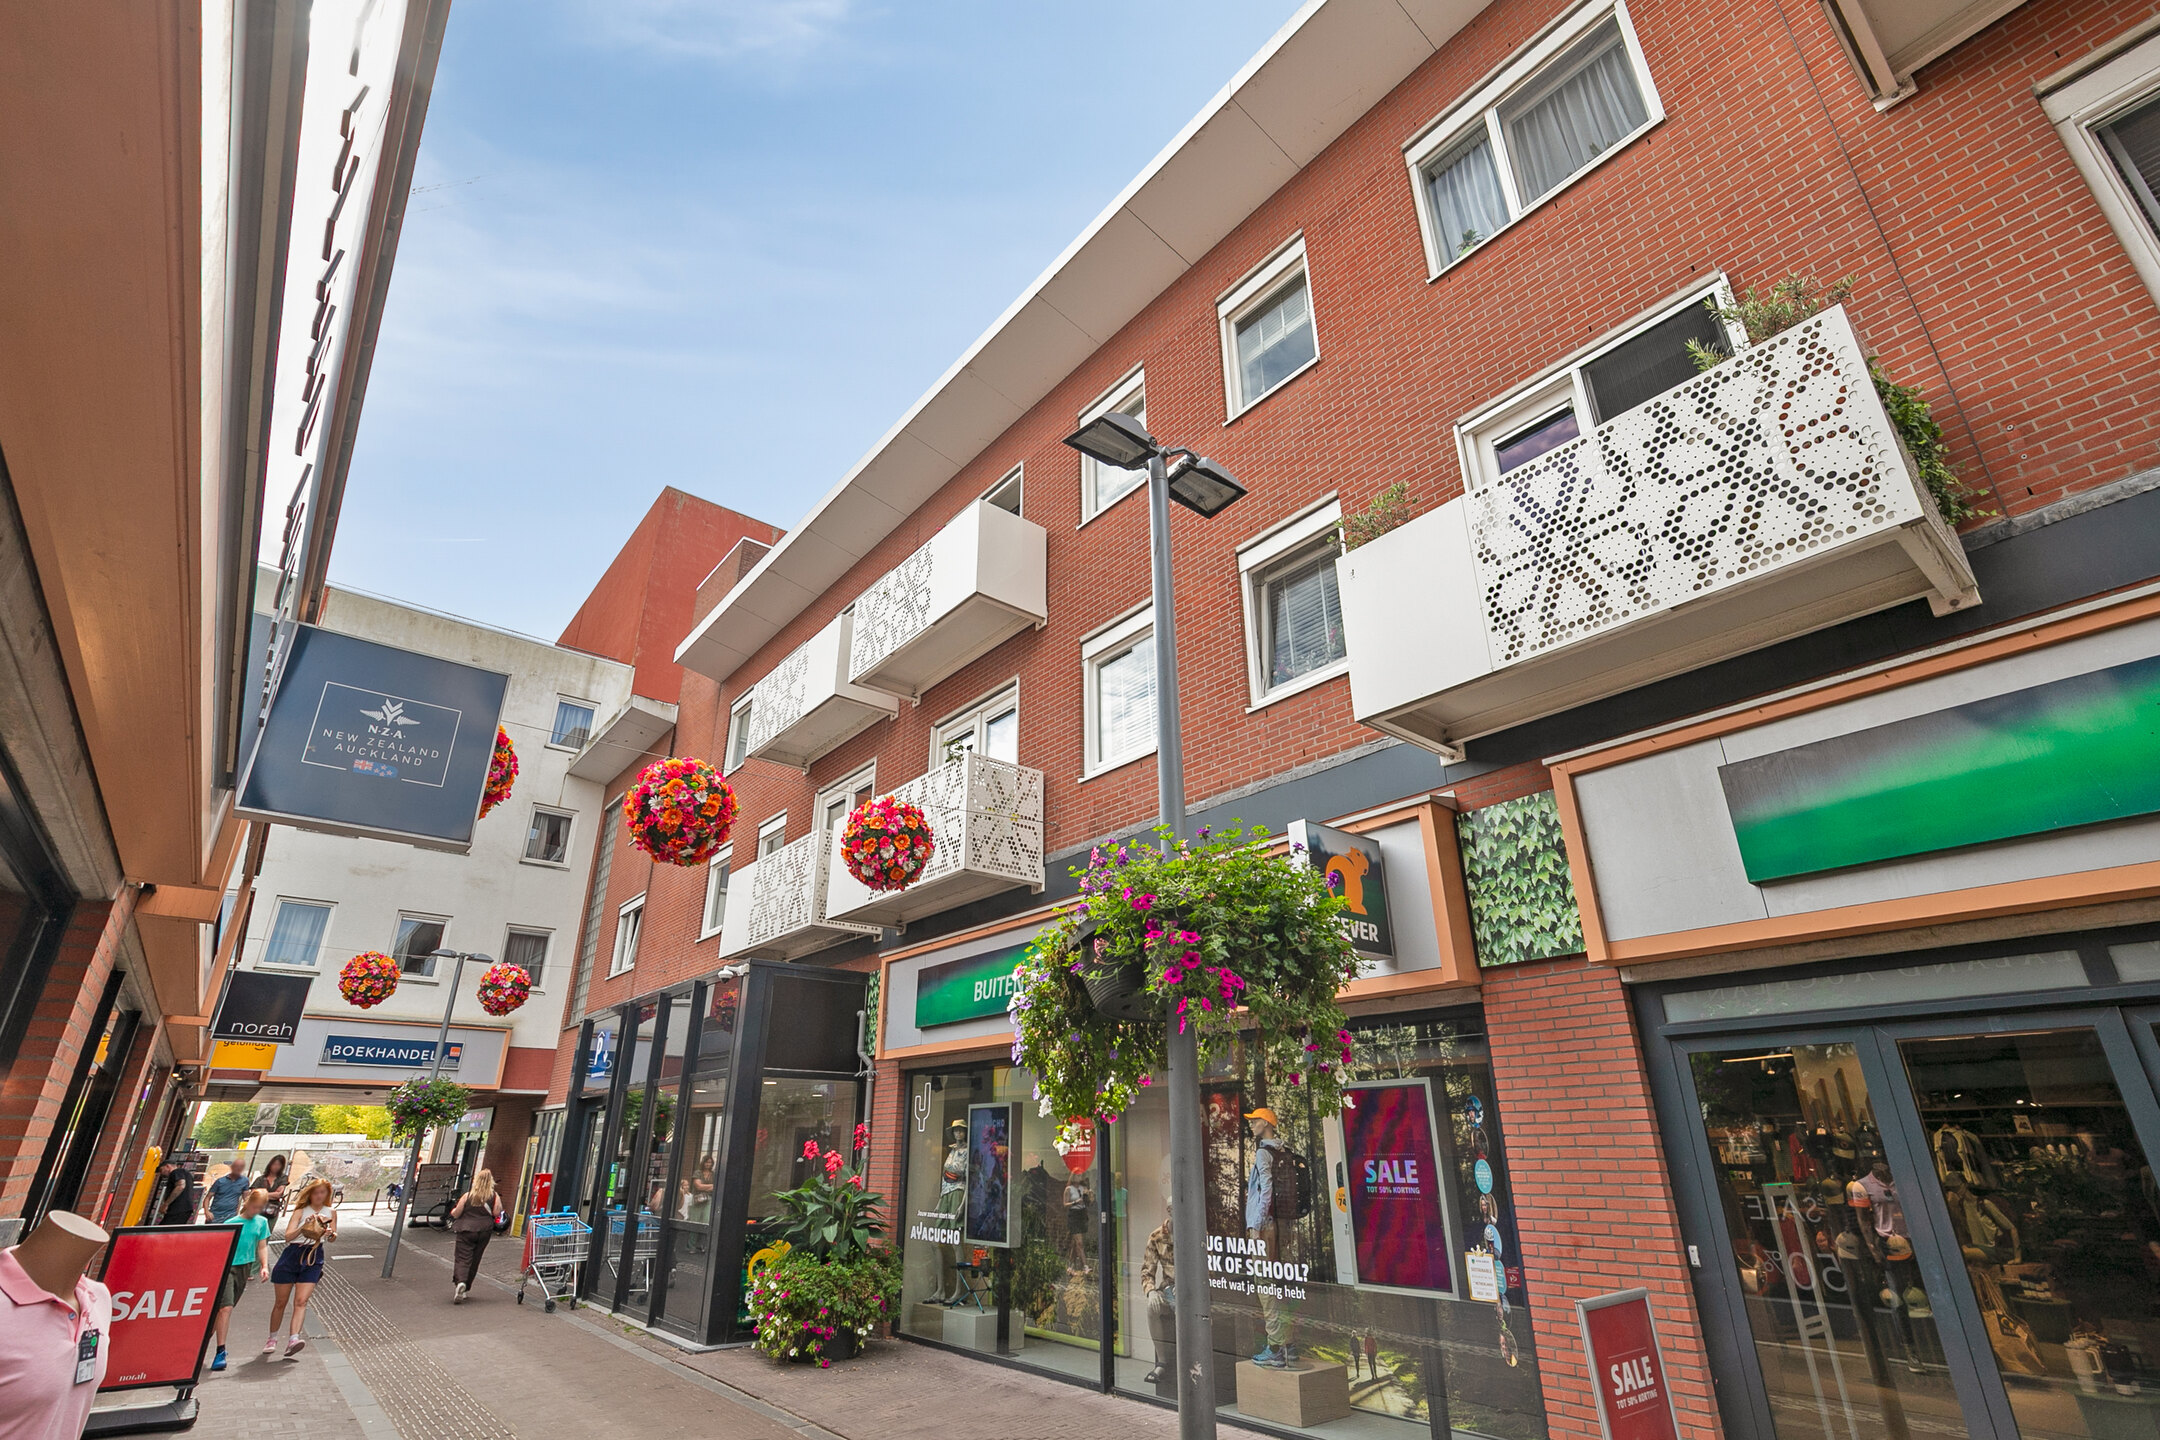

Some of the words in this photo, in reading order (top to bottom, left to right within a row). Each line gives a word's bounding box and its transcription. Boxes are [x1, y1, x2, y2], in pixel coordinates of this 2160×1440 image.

[322, 728, 359, 743] NEW
[366, 737, 440, 759] ZEALAND
[334, 743, 423, 766] AUCKLAND
[230, 1021, 293, 1037] norah
[332, 1044, 437, 1061] BOEKHANDEL
[1363, 1160, 1419, 1184] SALE
[1393, 1186, 1420, 1195] KORTING
[910, 1221, 961, 1246] AYACUCHO
[1226, 1237, 1267, 1256] NAAR
[1225, 1256, 1242, 1274] OF
[1245, 1258, 1309, 1282] SCHOOL?
[1229, 1280, 1246, 1292] wat
[1246, 1281, 1255, 1296] je
[1257, 1283, 1283, 1300] nodig
[1284, 1285, 1306, 1300] hebt
[111, 1287, 209, 1322] SALE
[119, 1372, 147, 1382] norah
[1610, 1355, 1655, 1396] SALE
[1616, 1398, 1627, 1410] TOT
[1638, 1388, 1658, 1404] KORTING
